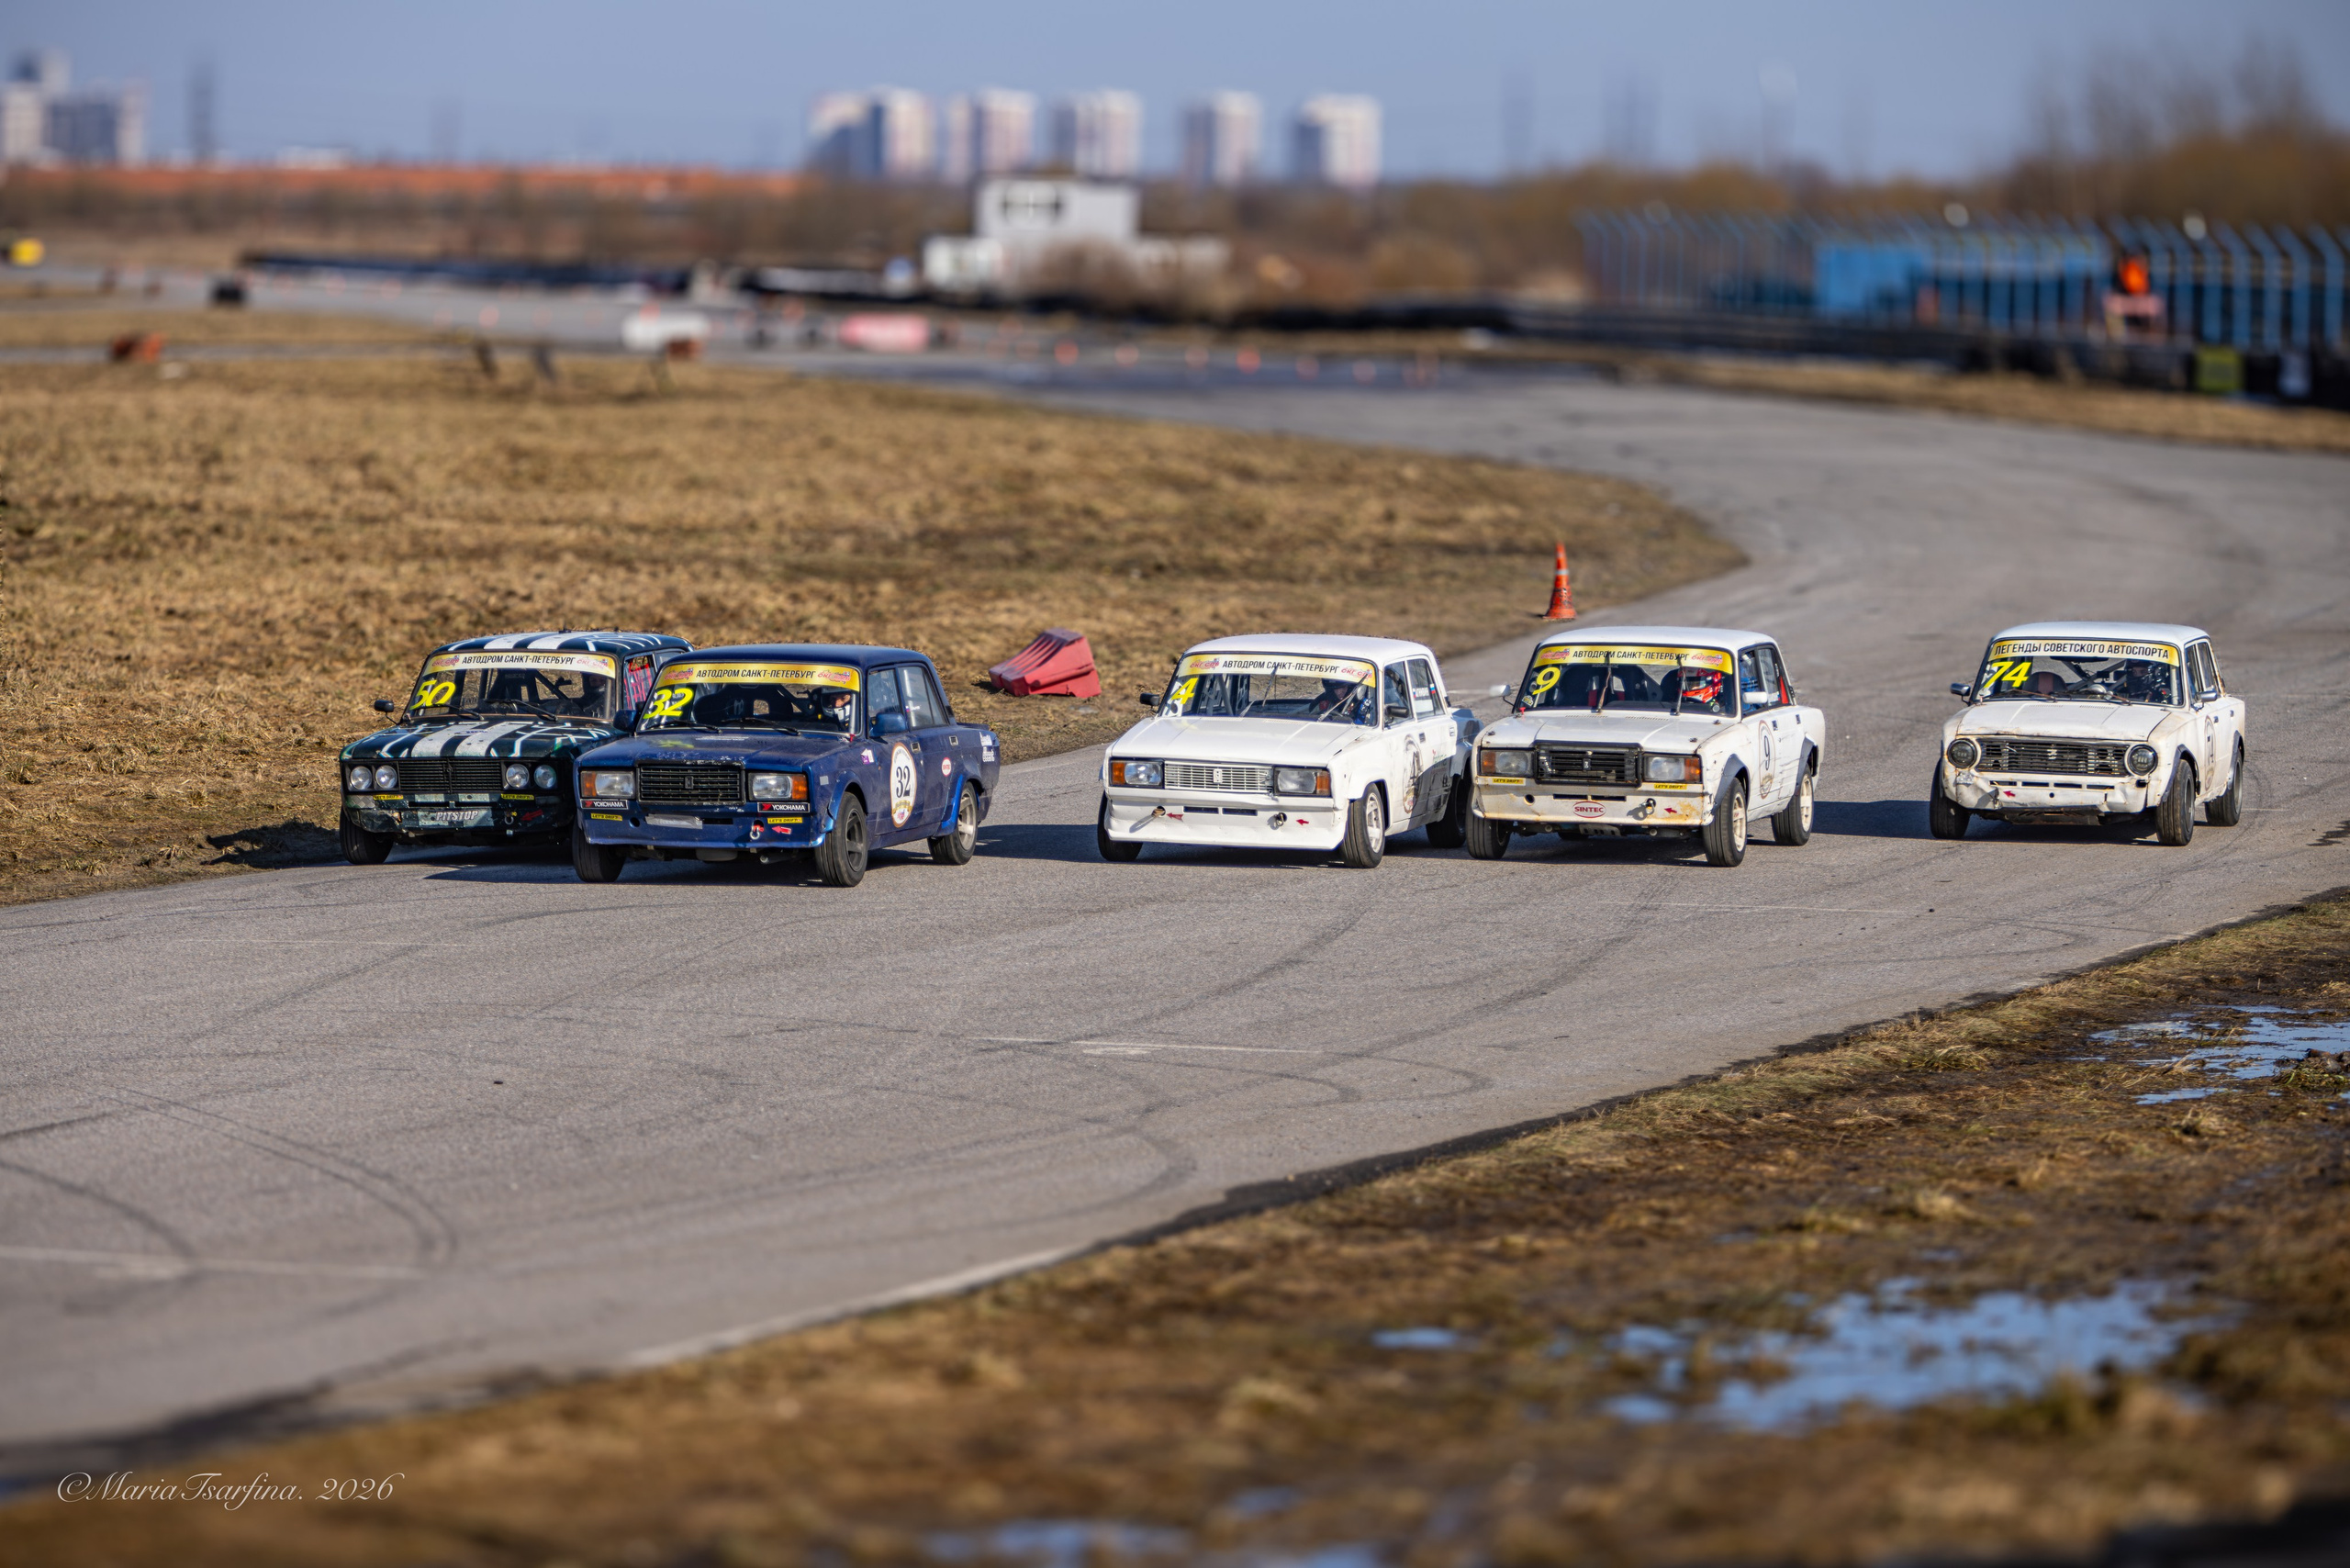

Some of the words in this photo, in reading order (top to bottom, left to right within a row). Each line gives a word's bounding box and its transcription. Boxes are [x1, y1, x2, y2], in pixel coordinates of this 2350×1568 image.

[462, 655, 504, 665] АВТОДРОМ
[505, 655, 576, 665] САНКТ-ПЕТЕРБУРГ
[1572, 650, 1616, 659] АВТОДРОМ
[1617, 651, 1690, 661] САНКТ-ПЕТЕРБУРГ
[1995, 644, 2041, 655] ЛЕГЕНДЫ
[2044, 643, 2104, 653] СОВЕТСКОГО
[2107, 644, 2169, 659] АВТОСПОРТА
[696, 668, 740, 678] АВТОДРОМ
[741, 669, 816, 679] САНКТ-ПЕТЕРБУРГ
[1222, 660, 1265, 669] АВТОДРОМ
[1266, 660, 1340, 673] САНКТ-ПЕТЕРБУРГ
[1983, 661, 2031, 688] 74
[1532, 666, 1561, 695] 9
[409, 680, 456, 711] 50
[1171, 678, 1198, 705] 4
[643, 688, 693, 719] 32
[1763, 735, 1771, 771] 9
[896, 766, 912, 798] 32
[436, 810, 479, 821] PITSTOP
[1574, 805, 1605, 814] SINTEC
